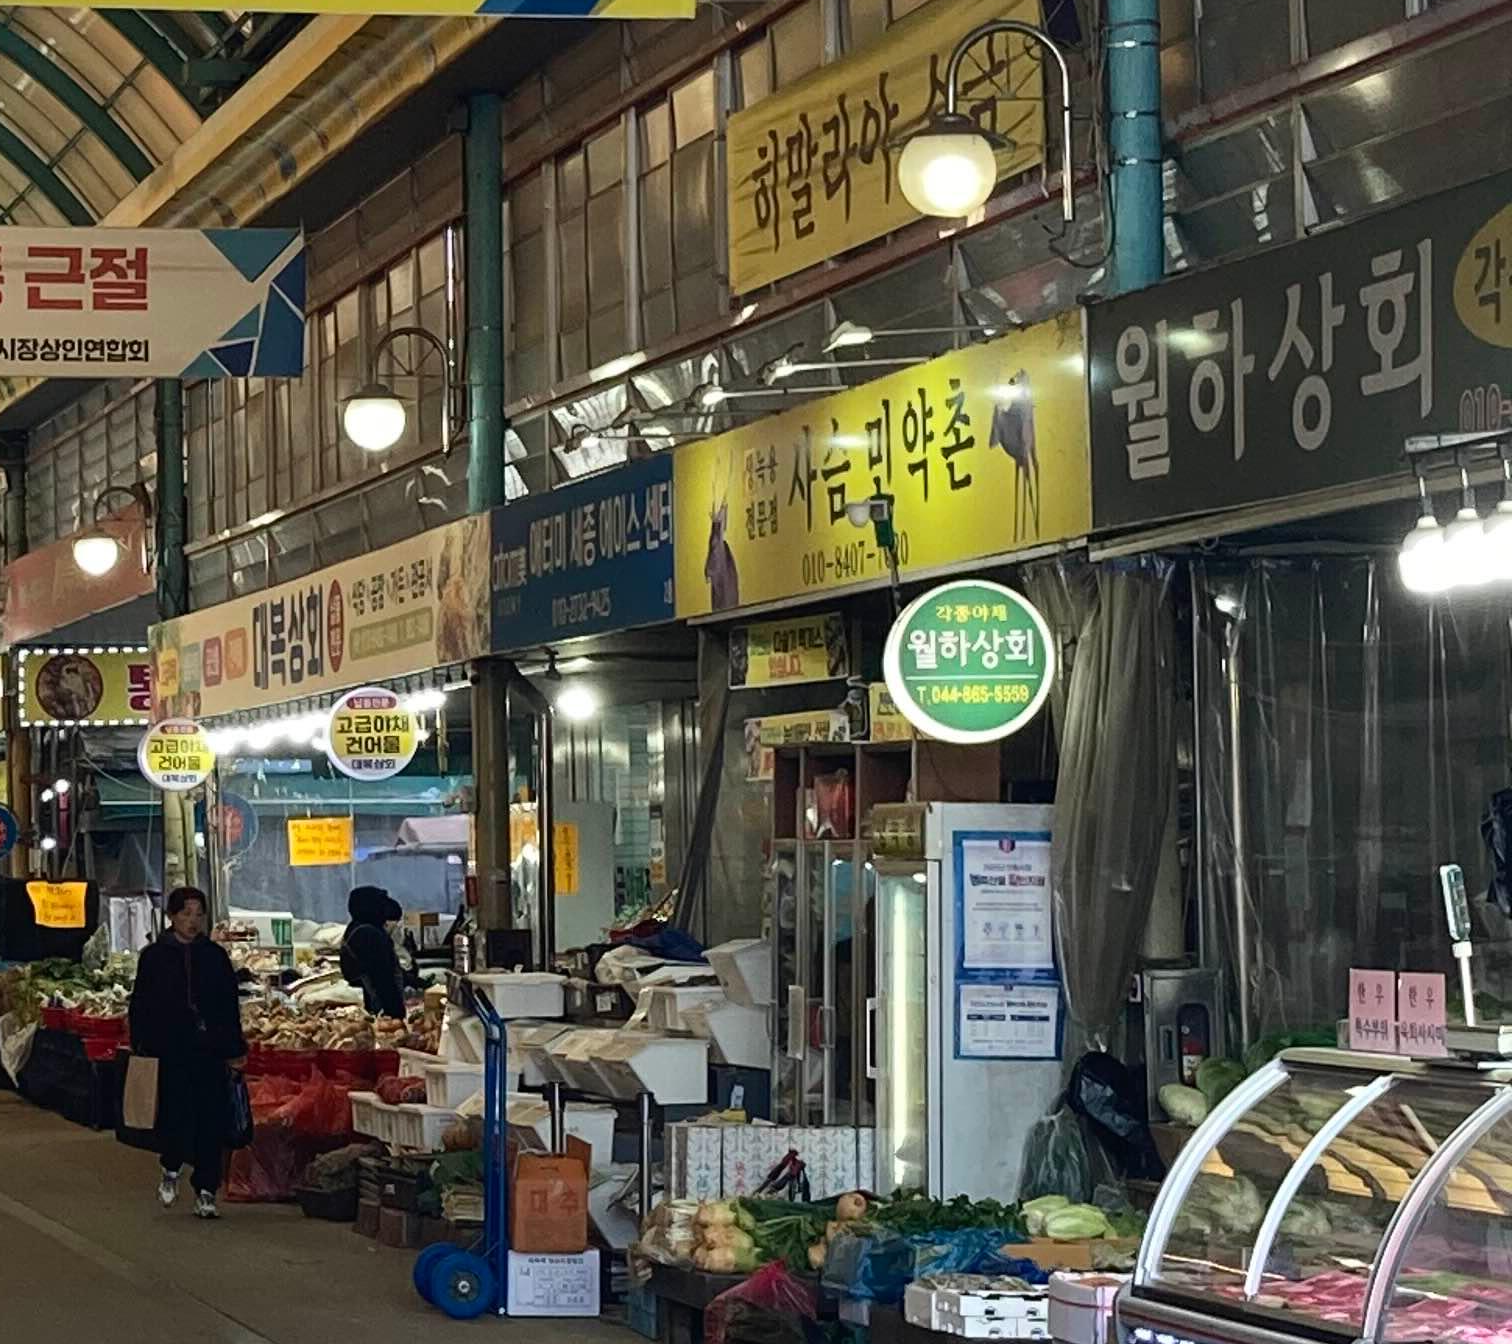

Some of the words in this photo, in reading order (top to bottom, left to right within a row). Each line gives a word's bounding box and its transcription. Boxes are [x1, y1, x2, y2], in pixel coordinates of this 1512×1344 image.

[751, 71, 899, 255] 히말라야
[24, 248, 150, 312] 근절
[1112, 238, 1433, 481] 월하상회
[1474, 239, 1512, 324] 각
[252, 583, 325, 692] 대복상회
[907, 629, 1035, 670] 월하상회
[336, 715, 410, 734] 고급야채
[346, 735, 400, 755] 건어물
